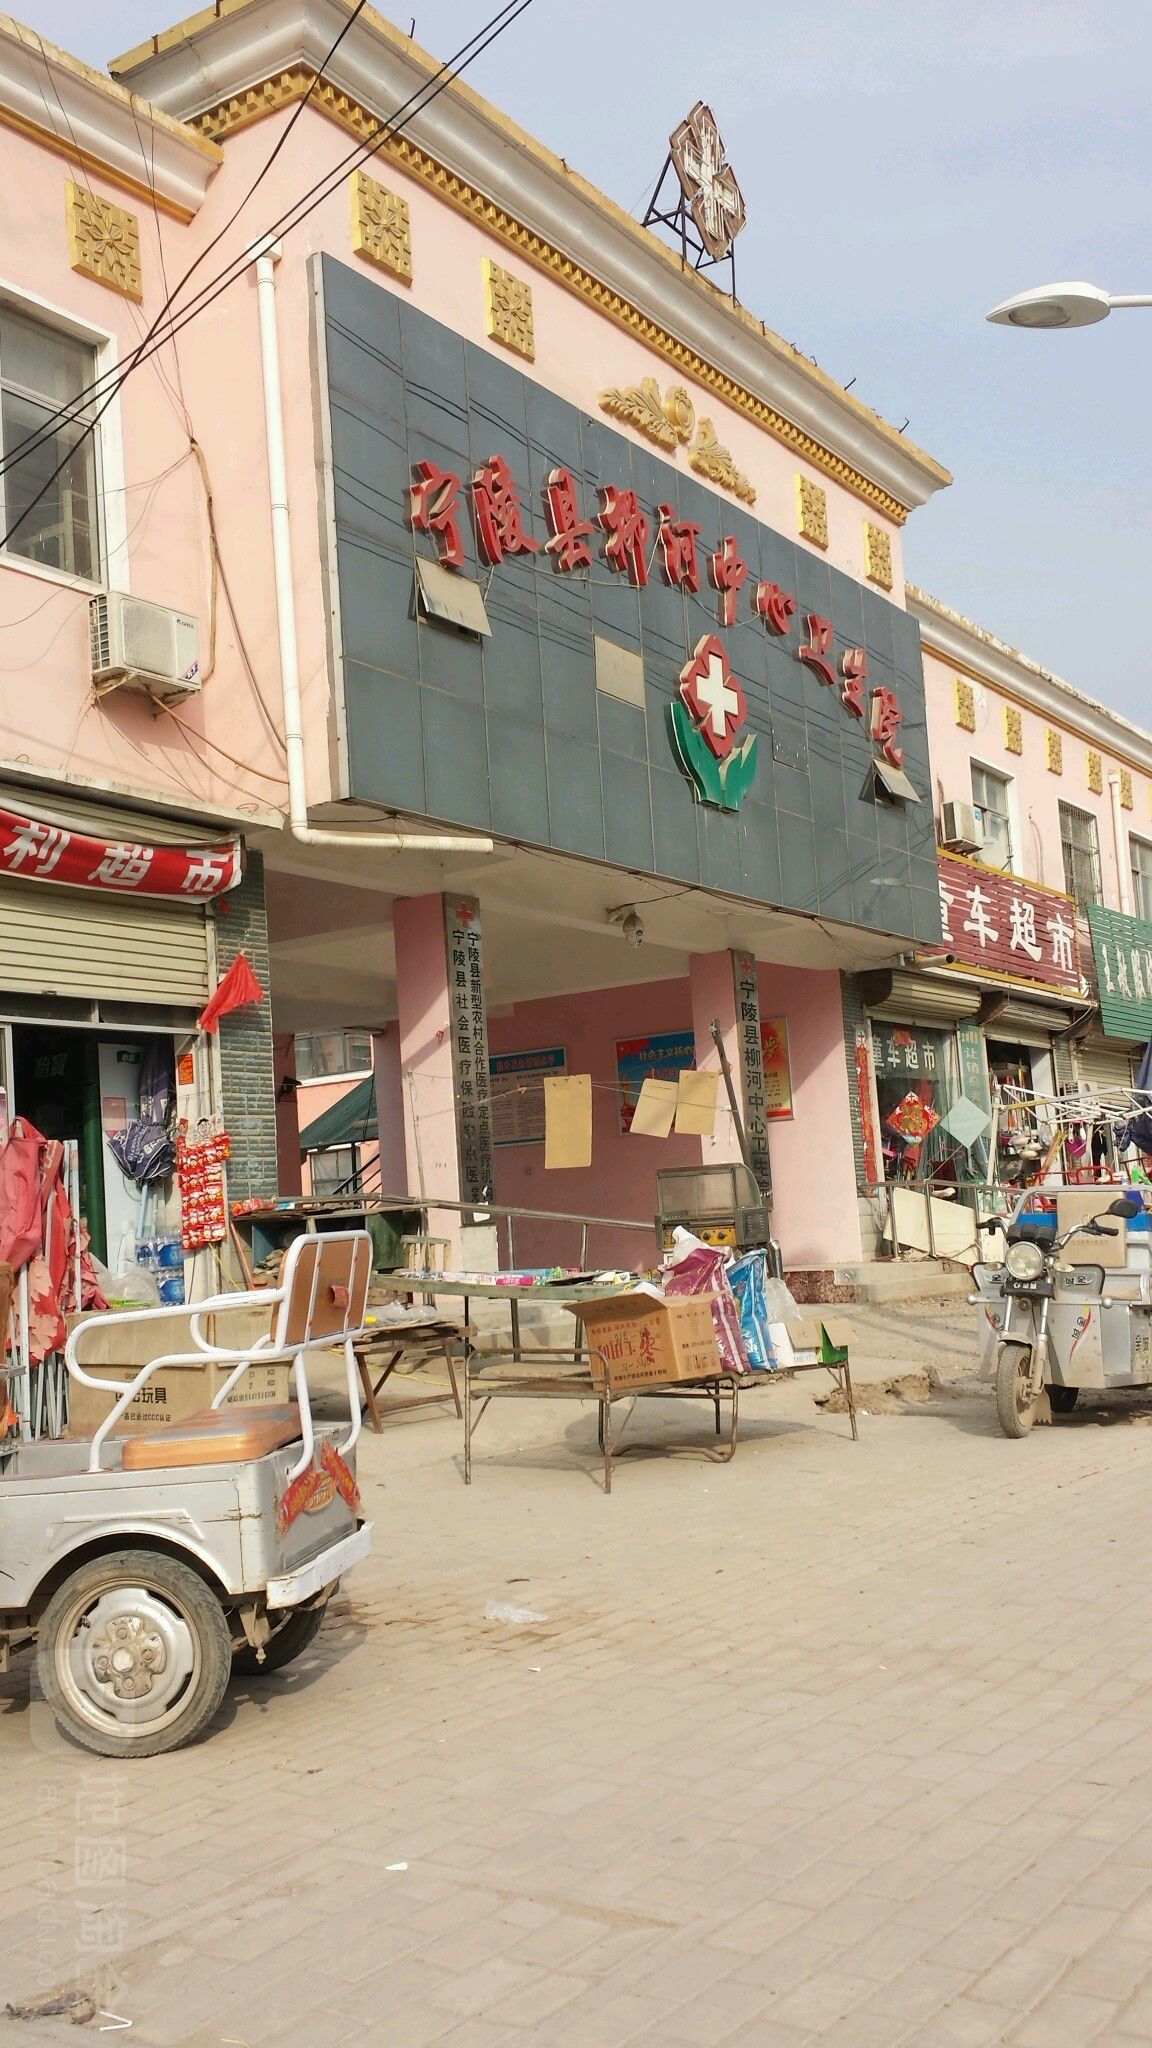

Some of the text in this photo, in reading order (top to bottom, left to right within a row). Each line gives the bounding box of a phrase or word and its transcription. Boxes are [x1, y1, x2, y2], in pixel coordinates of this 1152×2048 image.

[409, 454, 904, 767] 宁陵县柳河中心卫生院
[740, 980, 771, 1198] 宁陵县柳河中心卫生院
[115, 1387, 167, 1404] 玩具
[121, 1411, 172, 1422] 品已通过CCC认证
